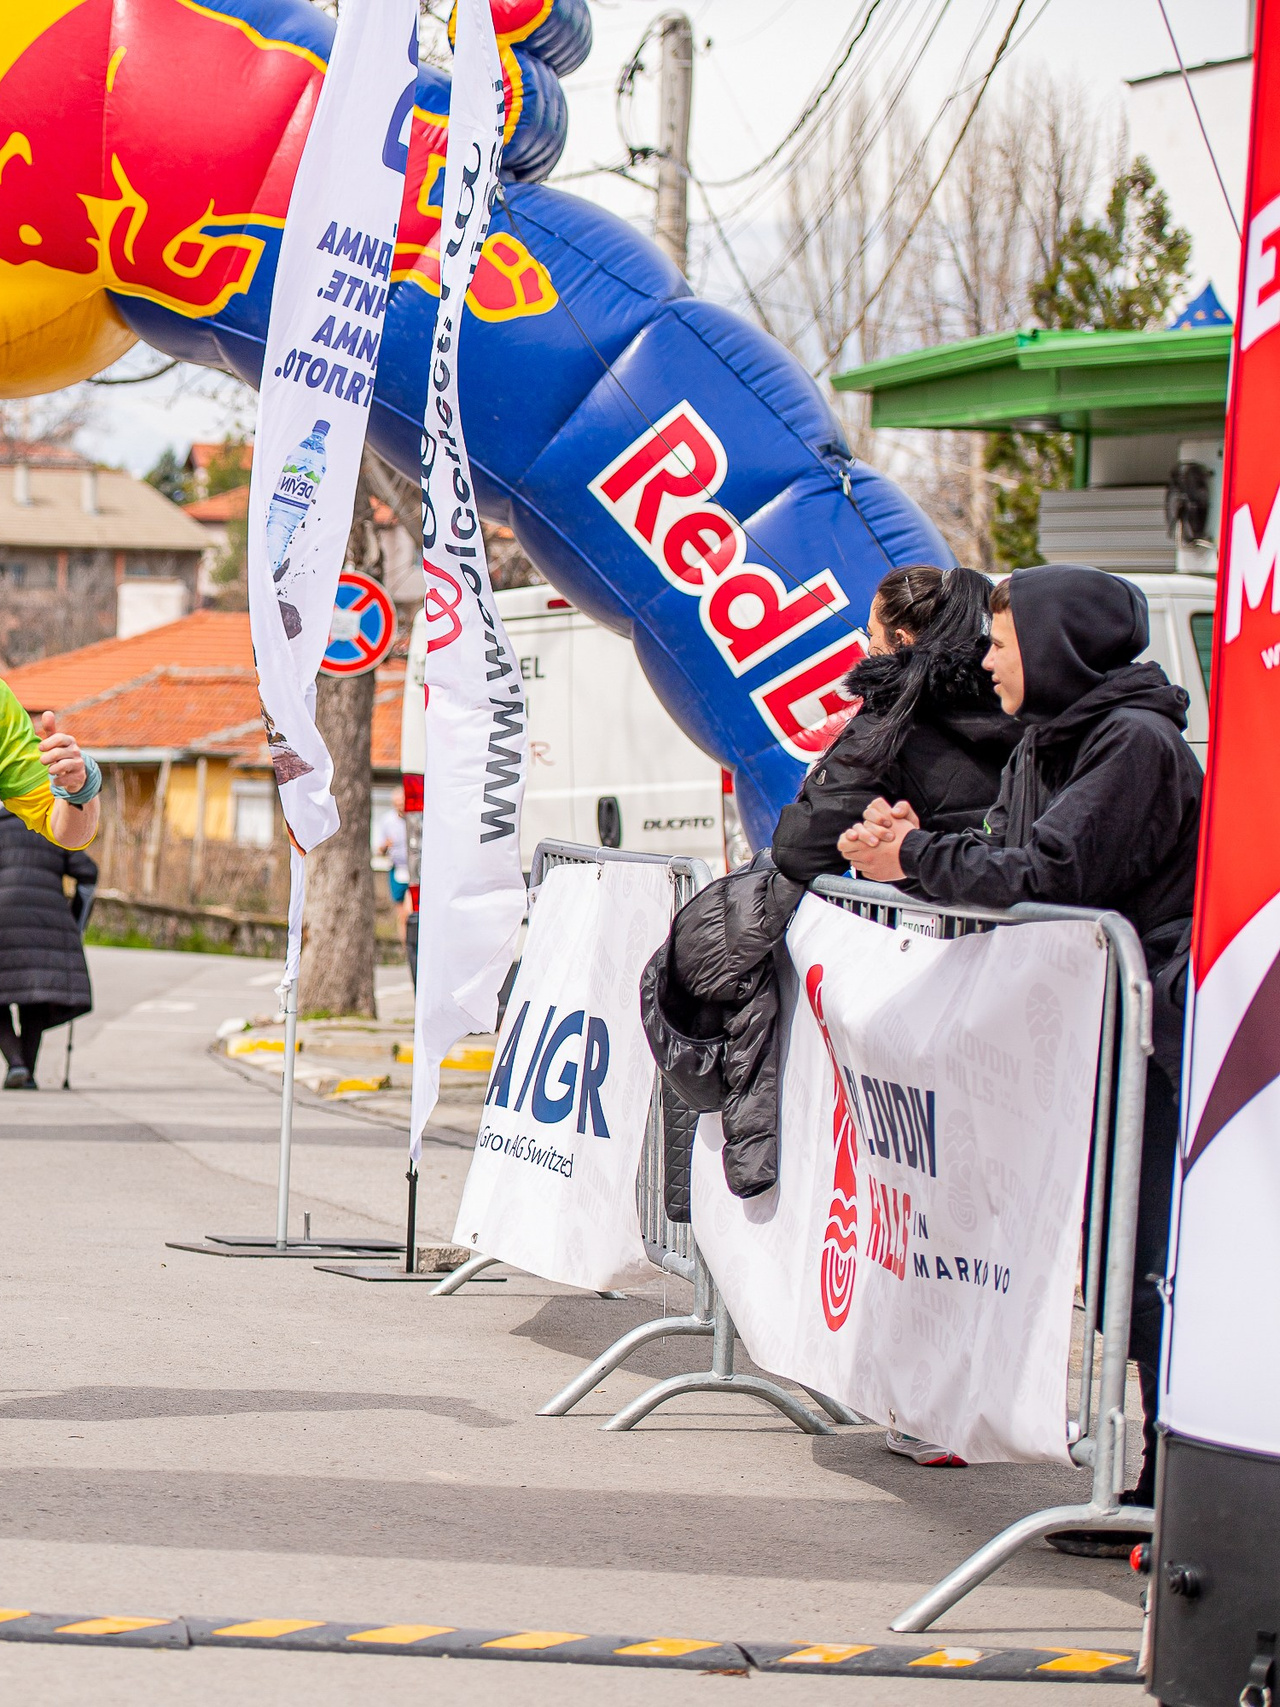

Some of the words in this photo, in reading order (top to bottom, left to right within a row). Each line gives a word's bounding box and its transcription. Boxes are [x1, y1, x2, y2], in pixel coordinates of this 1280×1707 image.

[594, 406, 842, 671] Red
[521, 657, 546, 679] EL
[643, 817, 715, 830] DUCATO
[866, 1173, 911, 1281] HILLS
[913, 1211, 929, 1239] IN
[913, 1252, 1011, 1295] MARKOVO
